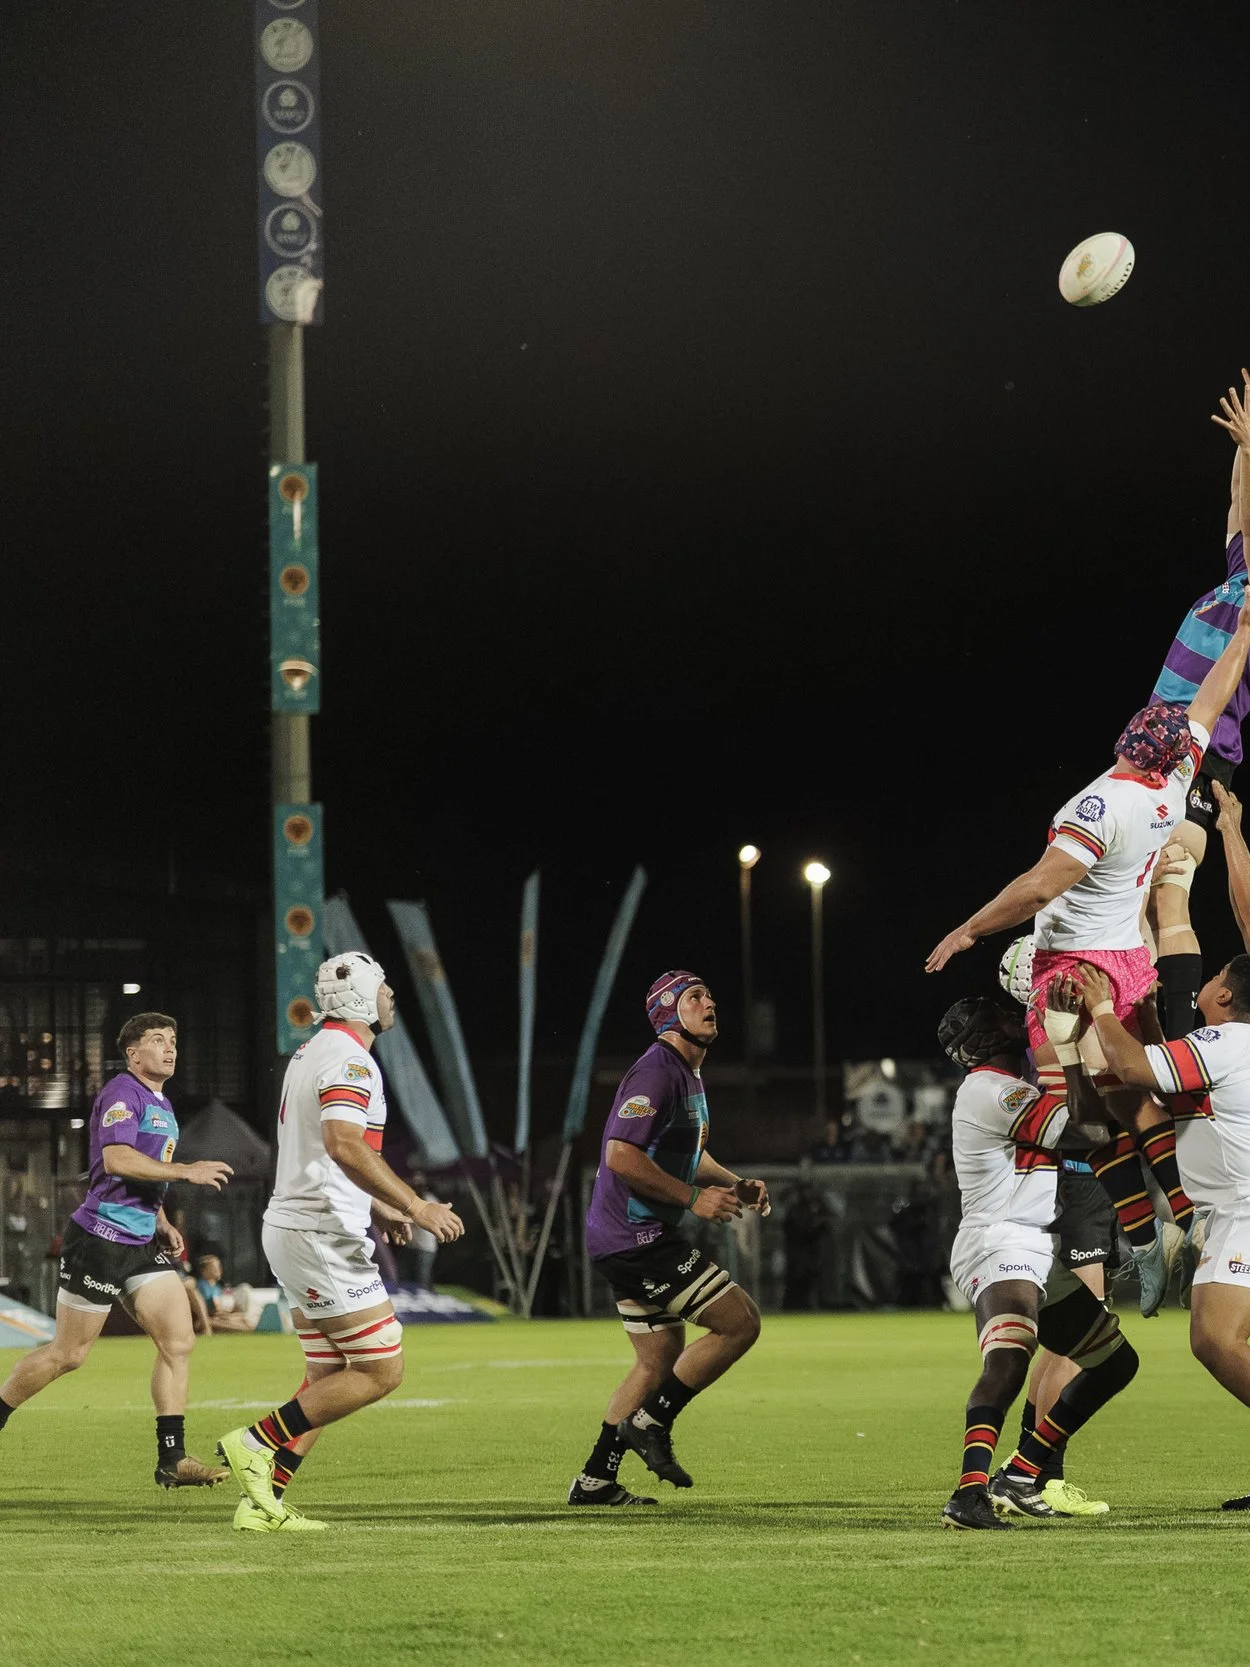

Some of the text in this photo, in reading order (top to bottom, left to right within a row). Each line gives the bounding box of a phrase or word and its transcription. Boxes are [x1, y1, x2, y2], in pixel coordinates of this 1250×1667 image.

[1084, 800, 1100, 811] TW
[1150, 819, 1175, 829] SUZUKI
[306, 1299, 335, 1309] SUZUKI
